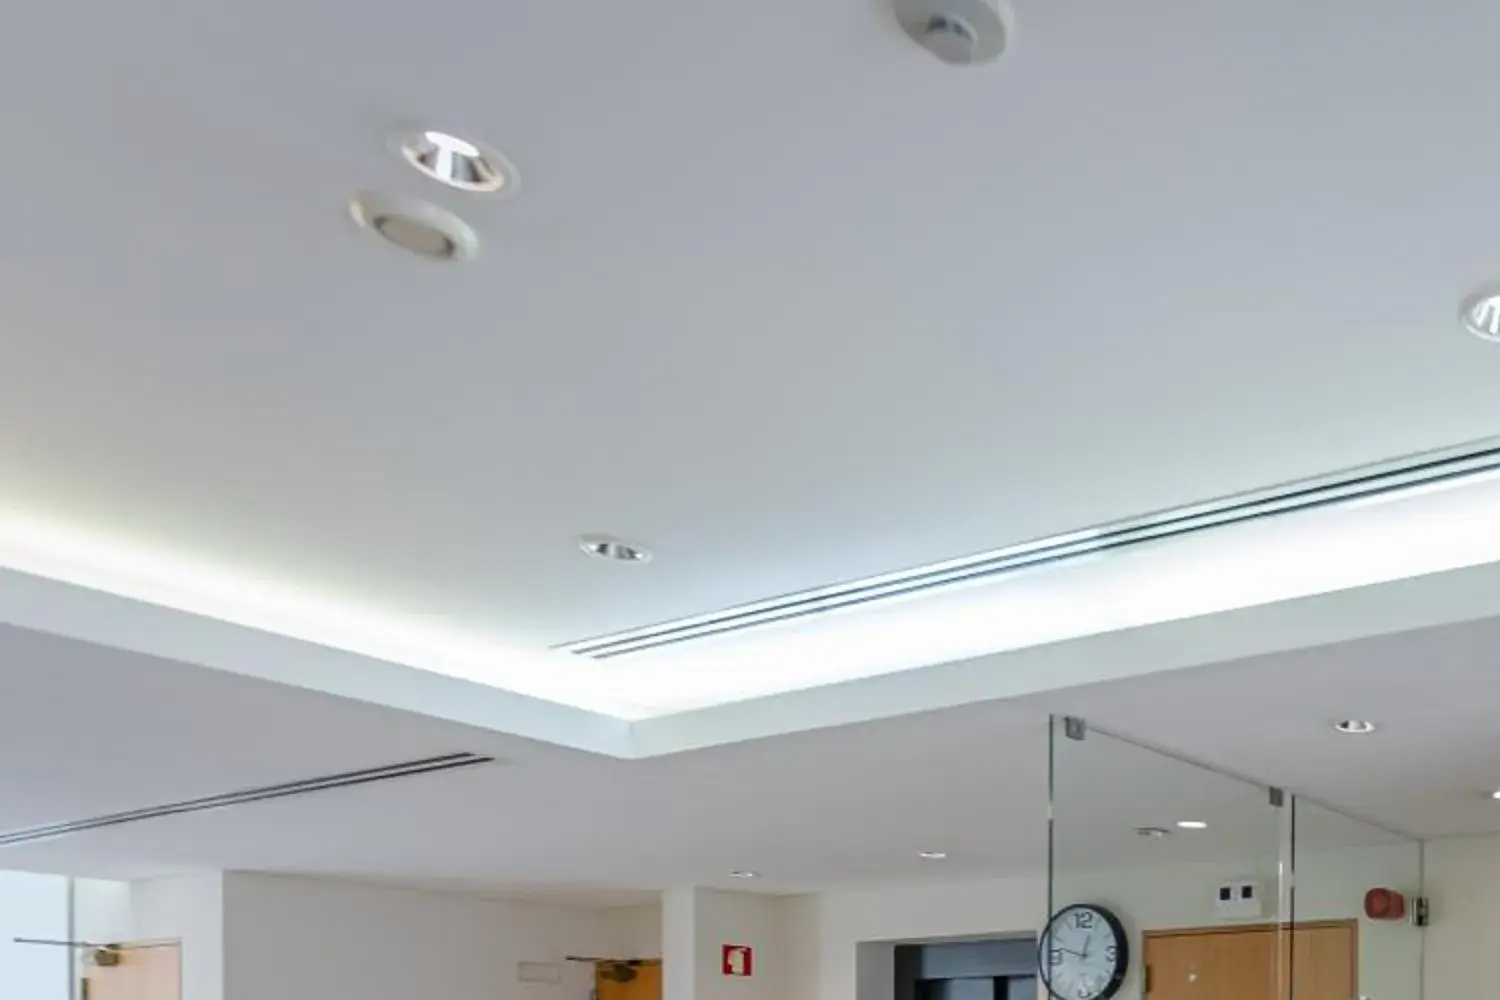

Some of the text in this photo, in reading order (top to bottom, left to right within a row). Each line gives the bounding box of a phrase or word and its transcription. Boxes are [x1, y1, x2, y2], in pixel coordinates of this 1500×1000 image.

[1073, 911, 1092, 929] 12
[1048, 948, 1063, 967] 9
[1105, 945, 1116, 963] 3
